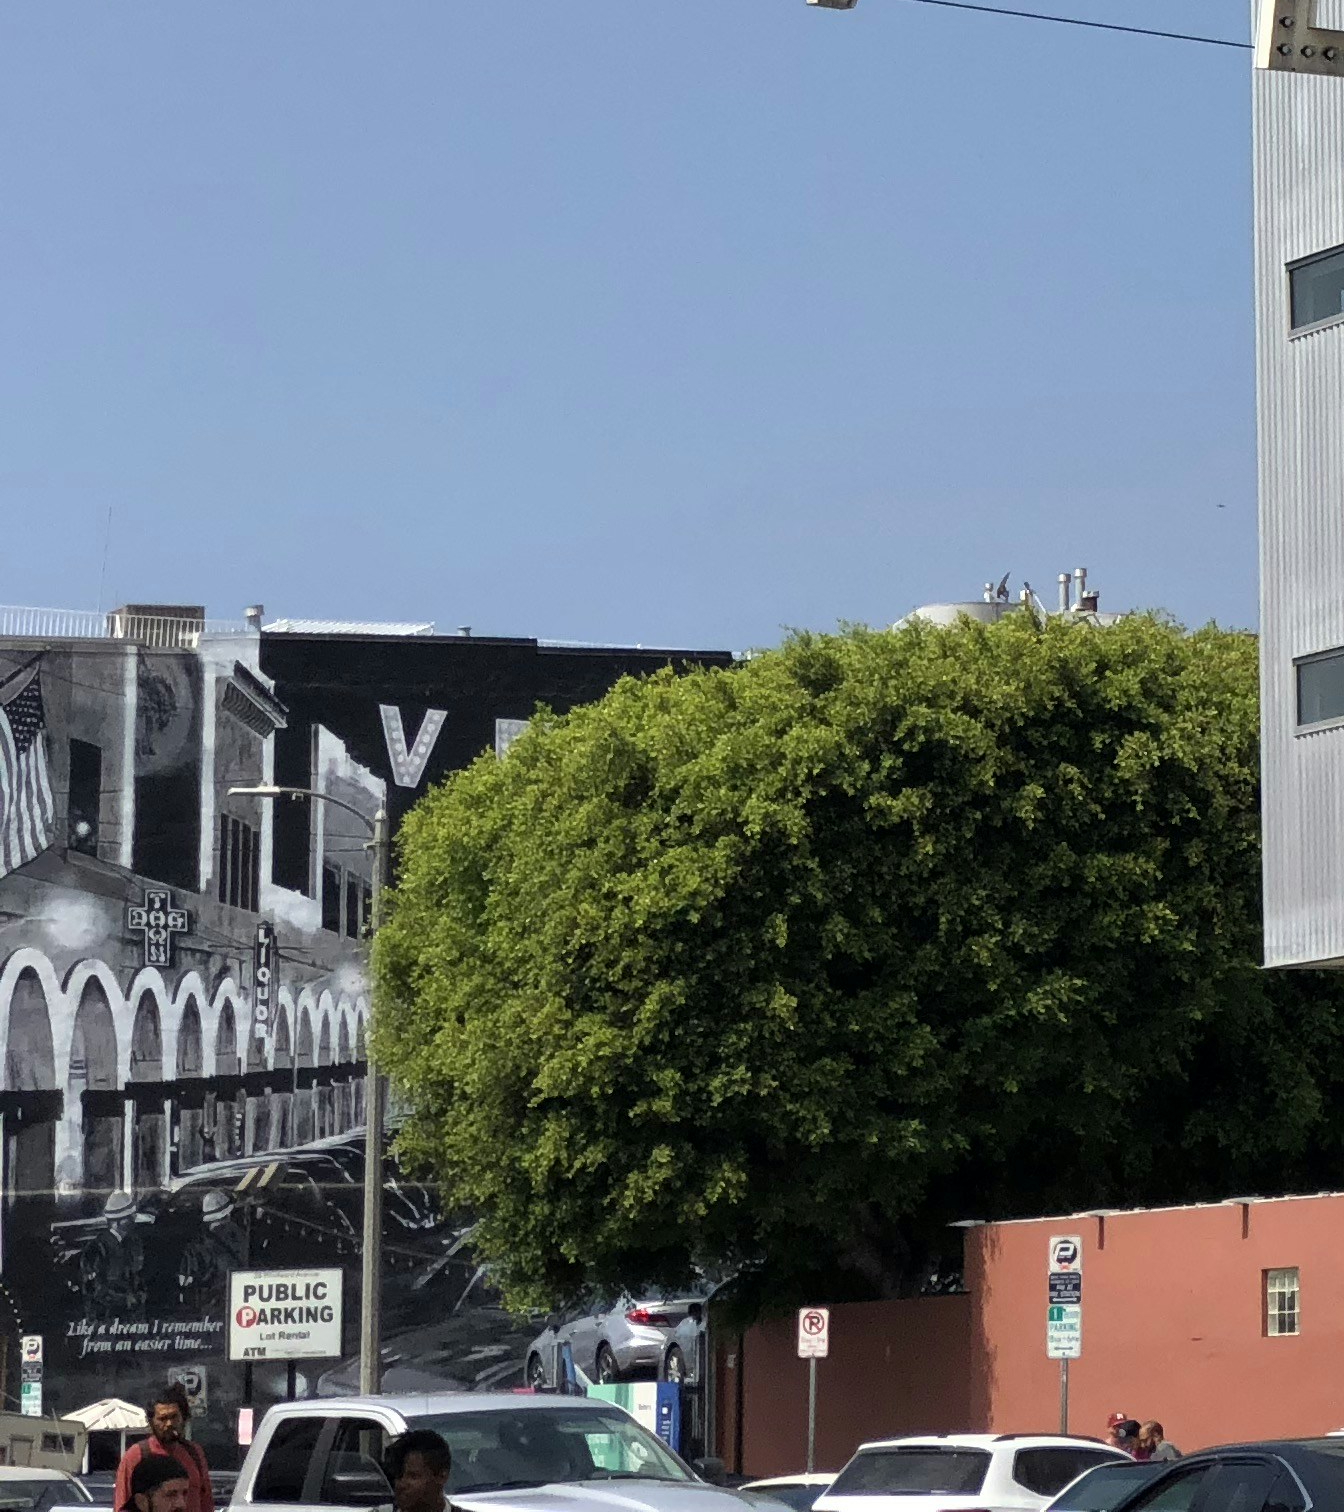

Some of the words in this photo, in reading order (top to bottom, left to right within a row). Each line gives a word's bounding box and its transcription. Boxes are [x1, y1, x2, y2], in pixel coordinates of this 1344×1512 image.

[243, 1281, 328, 1303] PUBLIC
[66, 1318, 95, 1336] Like
[97, 1324, 106, 1335] a
[109, 1317, 149, 1335] dream
[161, 1315, 224, 1334] remember
[238, 1304, 334, 1328] PARKING
[260, 1332, 276, 1341] Lot
[278, 1331, 311, 1341] Rental
[78, 1336, 112, 1359] from
[115, 1340, 132, 1352] an
[134, 1338, 172, 1351] easier
[174, 1335, 213, 1350] time...
[243, 1347, 267, 1358] ATM
